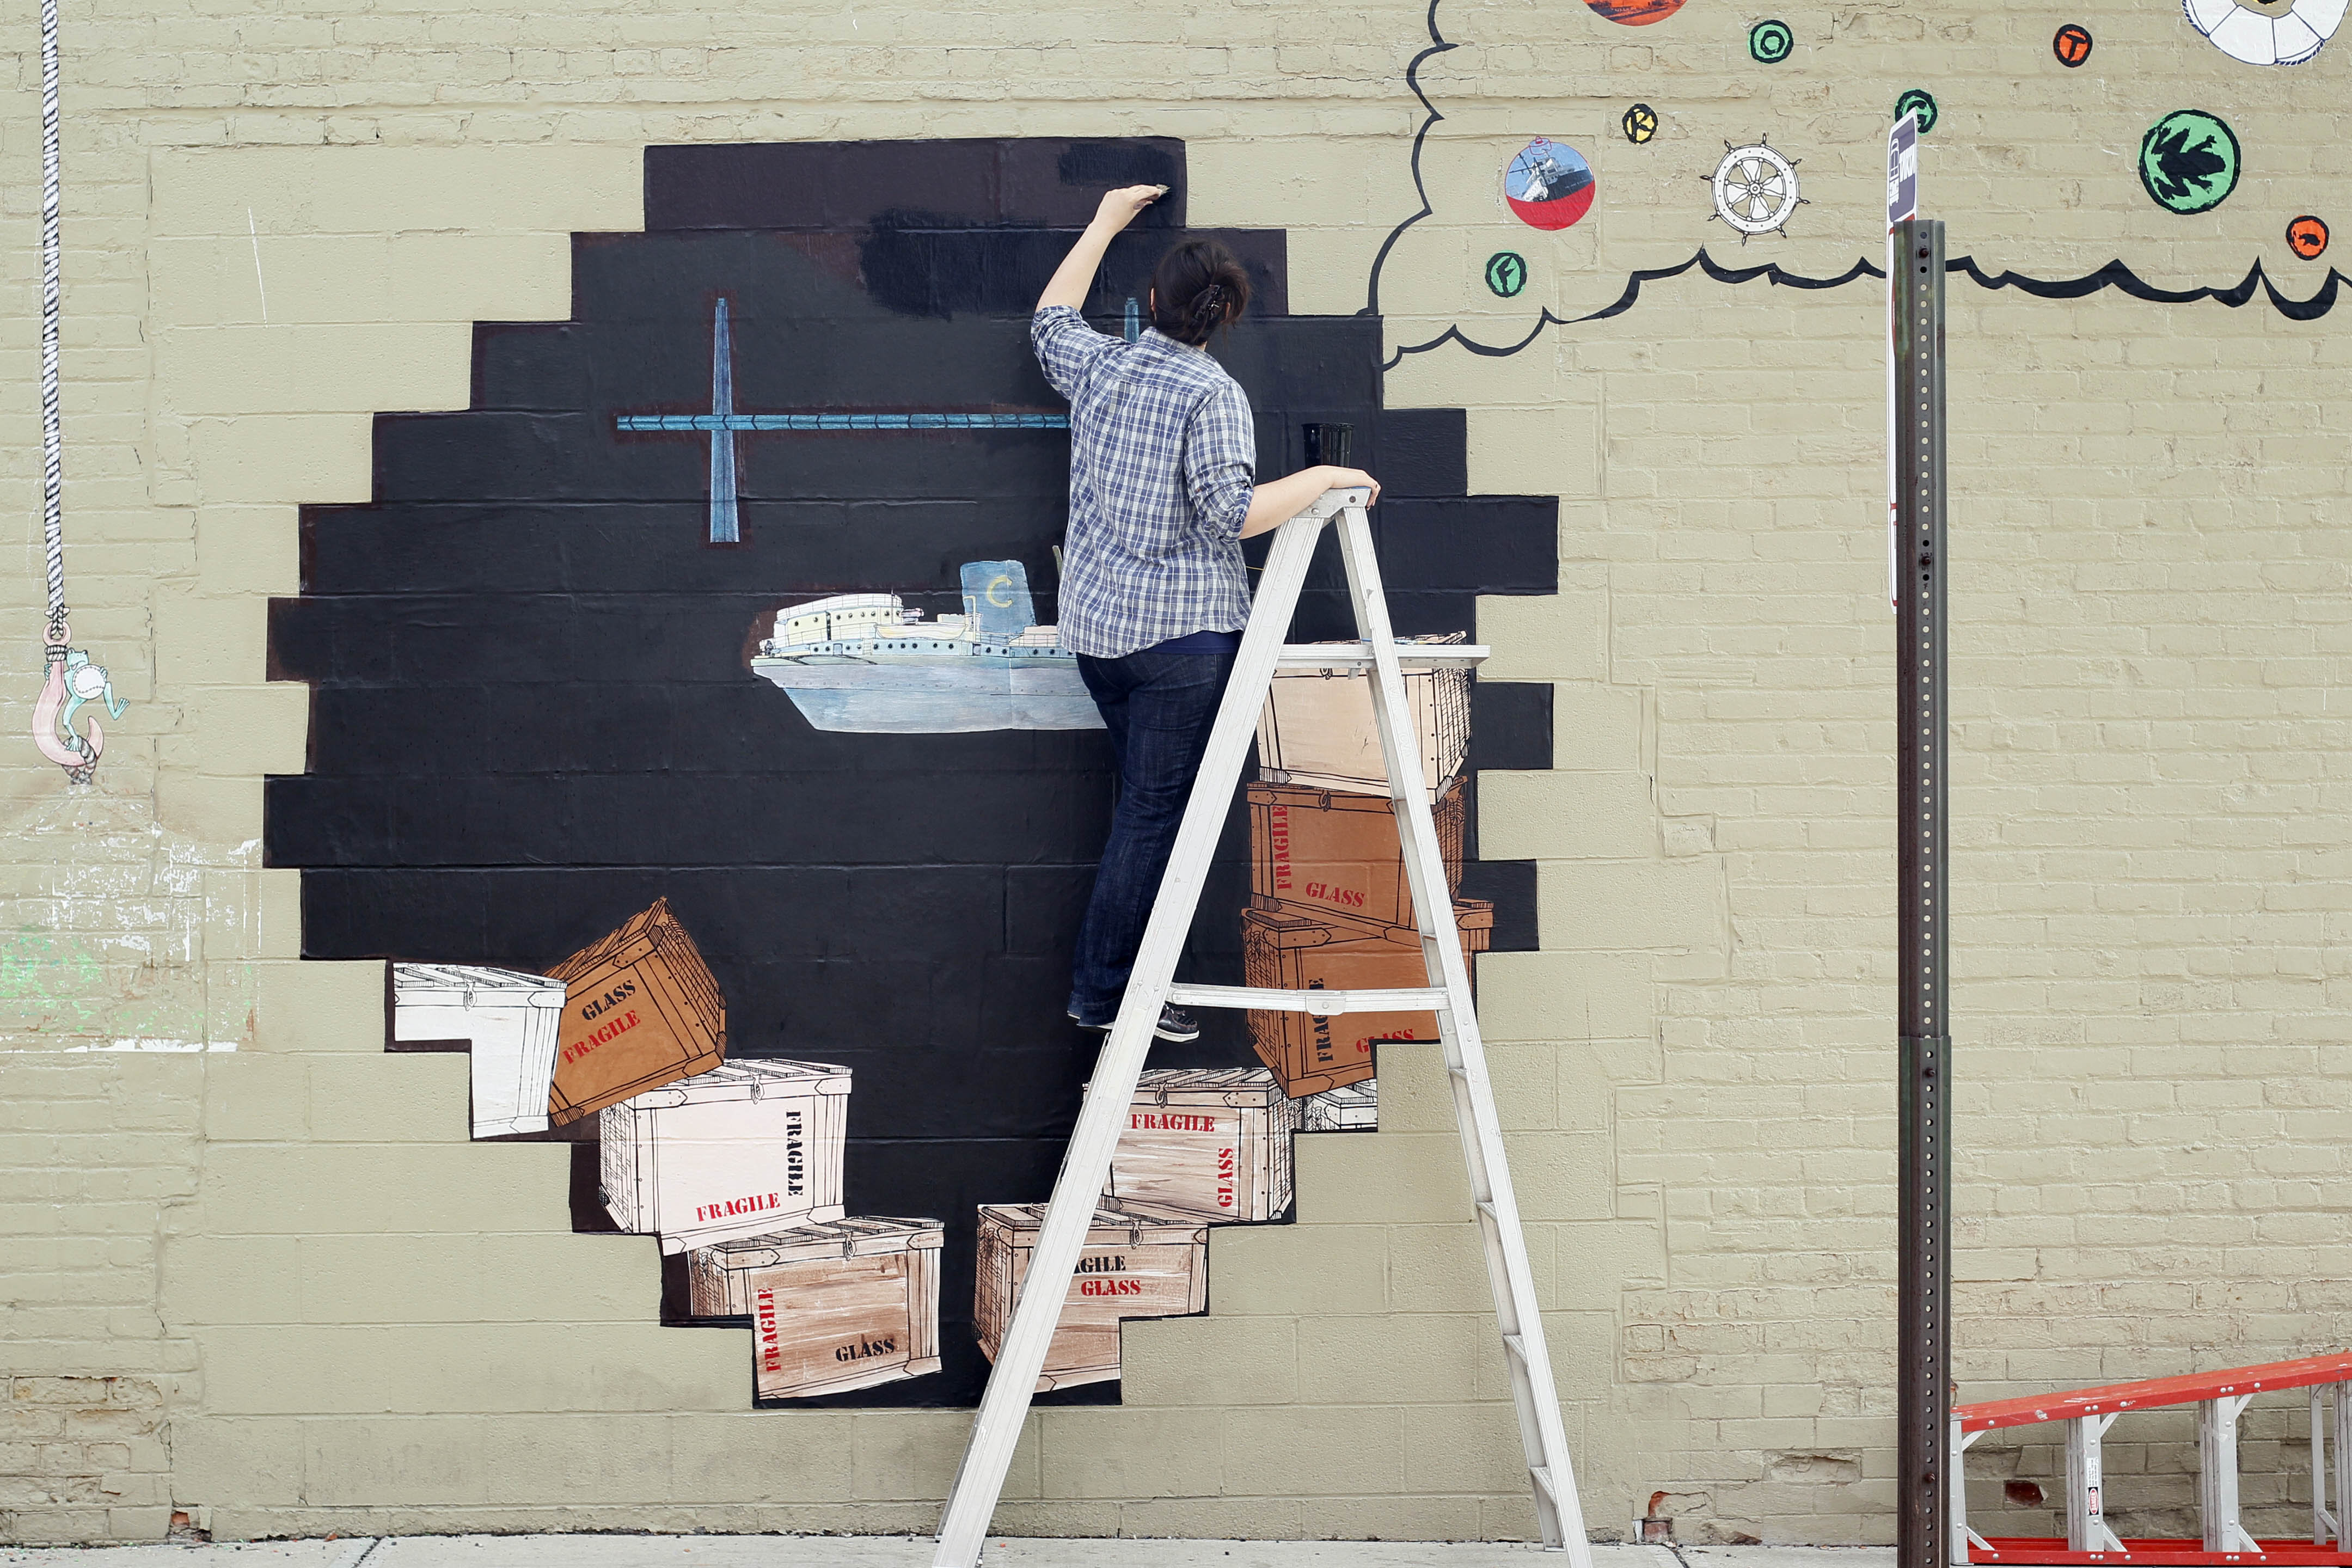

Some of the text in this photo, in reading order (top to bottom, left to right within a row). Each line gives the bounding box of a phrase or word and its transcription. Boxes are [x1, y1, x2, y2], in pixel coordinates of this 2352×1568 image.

[1760, 30, 1785, 55] O
[2065, 33, 2087, 60] T
[1496, 256, 1516, 293] F
[987, 575, 1012, 608] C
[1272, 805, 1292, 890] FRAGILE
[1306, 882, 1365, 908] GLASS
[582, 979, 636, 1020] GLASS
[1309, 978, 1333, 1063] FRAGE
[563, 1010, 640, 1064] FRAGILE
[1356, 1028, 1414, 1053] GSS
[1131, 1114, 1215, 1132] FRAGILE
[786, 1111, 803, 1196] FRAGILE
[1217, 1148, 1233, 1207] GLASS
[696, 1192, 780, 1222] FRAGILE
[1074, 1255, 1126, 1274] GILE
[1081, 1280, 1141, 1296] GLASS
[758, 1288, 781, 1372] FRAGILE
[836, 1339, 895, 1362] GLASS
